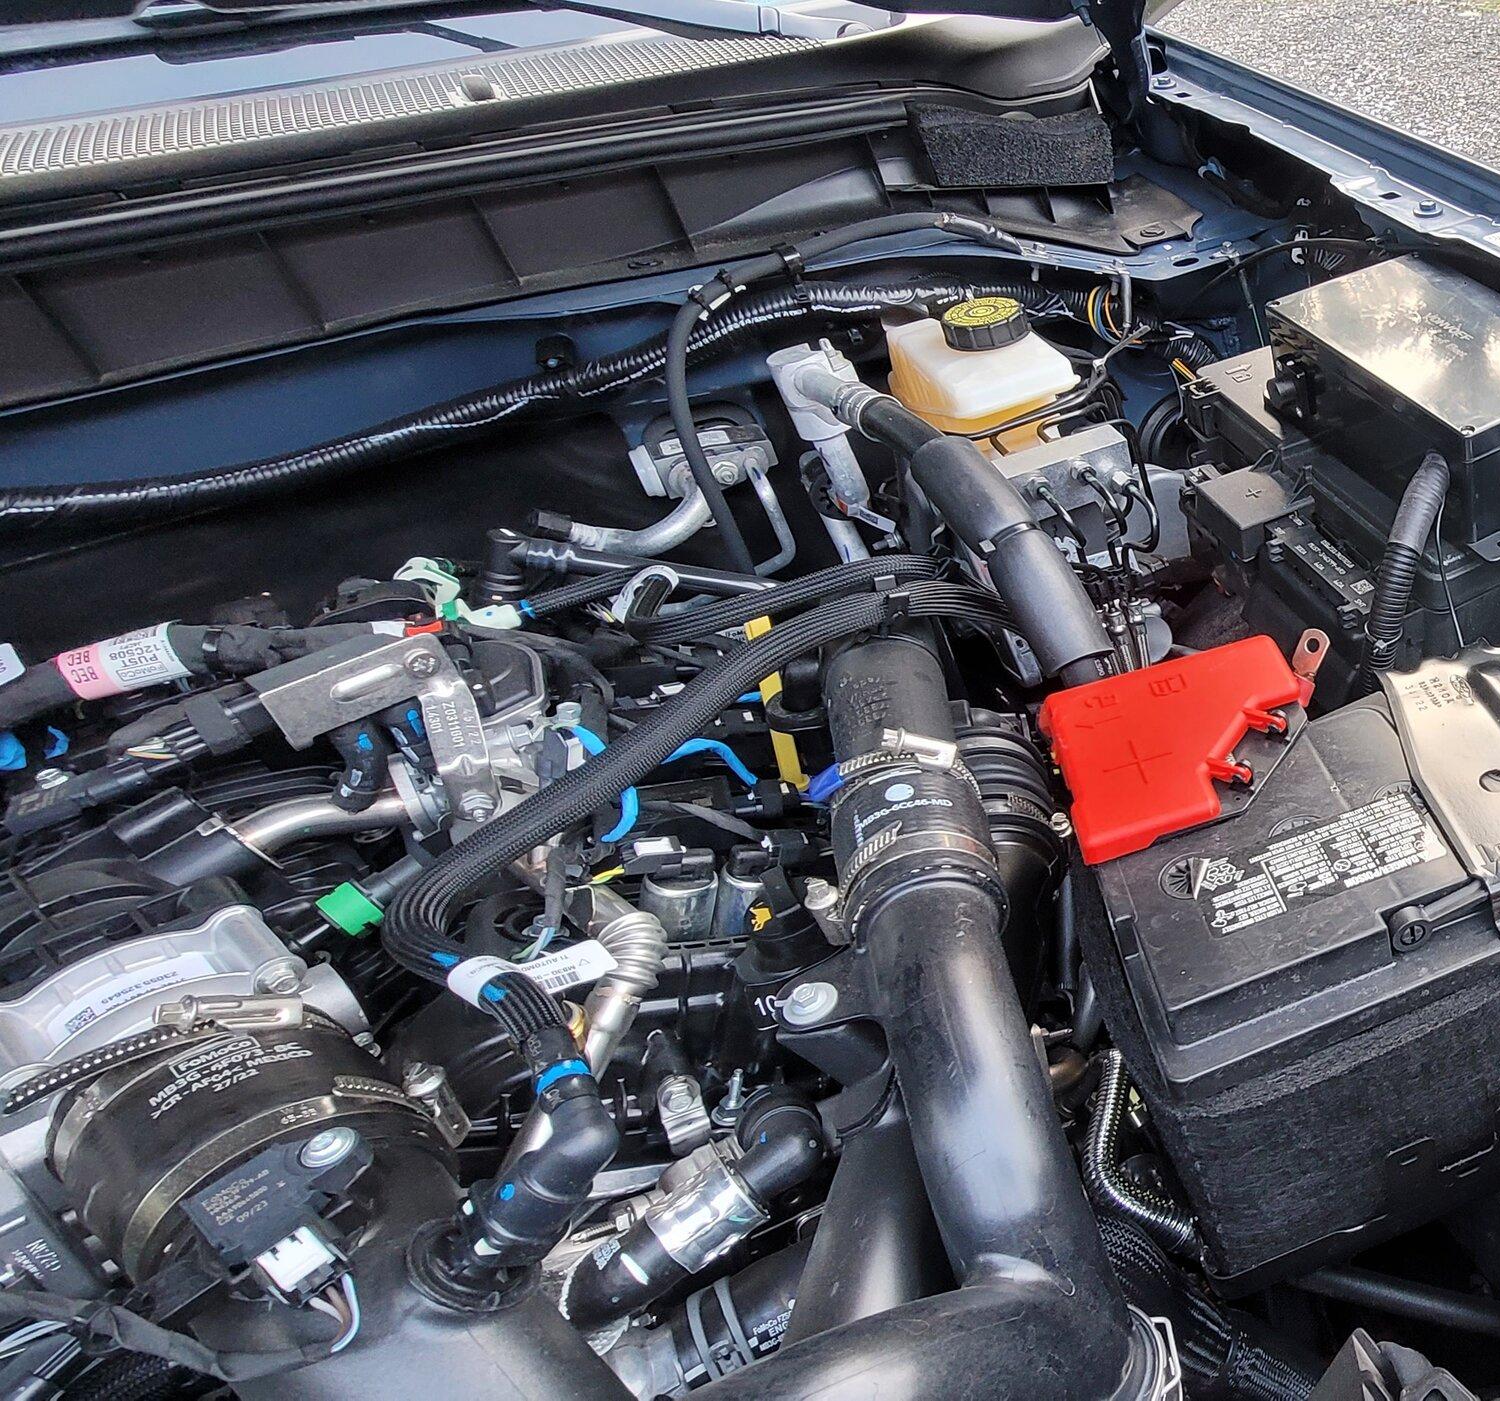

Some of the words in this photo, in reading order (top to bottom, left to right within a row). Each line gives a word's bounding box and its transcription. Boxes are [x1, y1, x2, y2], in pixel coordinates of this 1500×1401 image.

[64, 649, 92, 666] BEC
[68, 664, 99, 684] BEC
[119, 662, 164, 679] FoMoCo
[177, 1037, 252, 1072] FoMoCo
[246, 1050, 313, 1068] MEXICO
[211, 1066, 260, 1093] 27/22
[234, 1199, 268, 1224] 09/23
